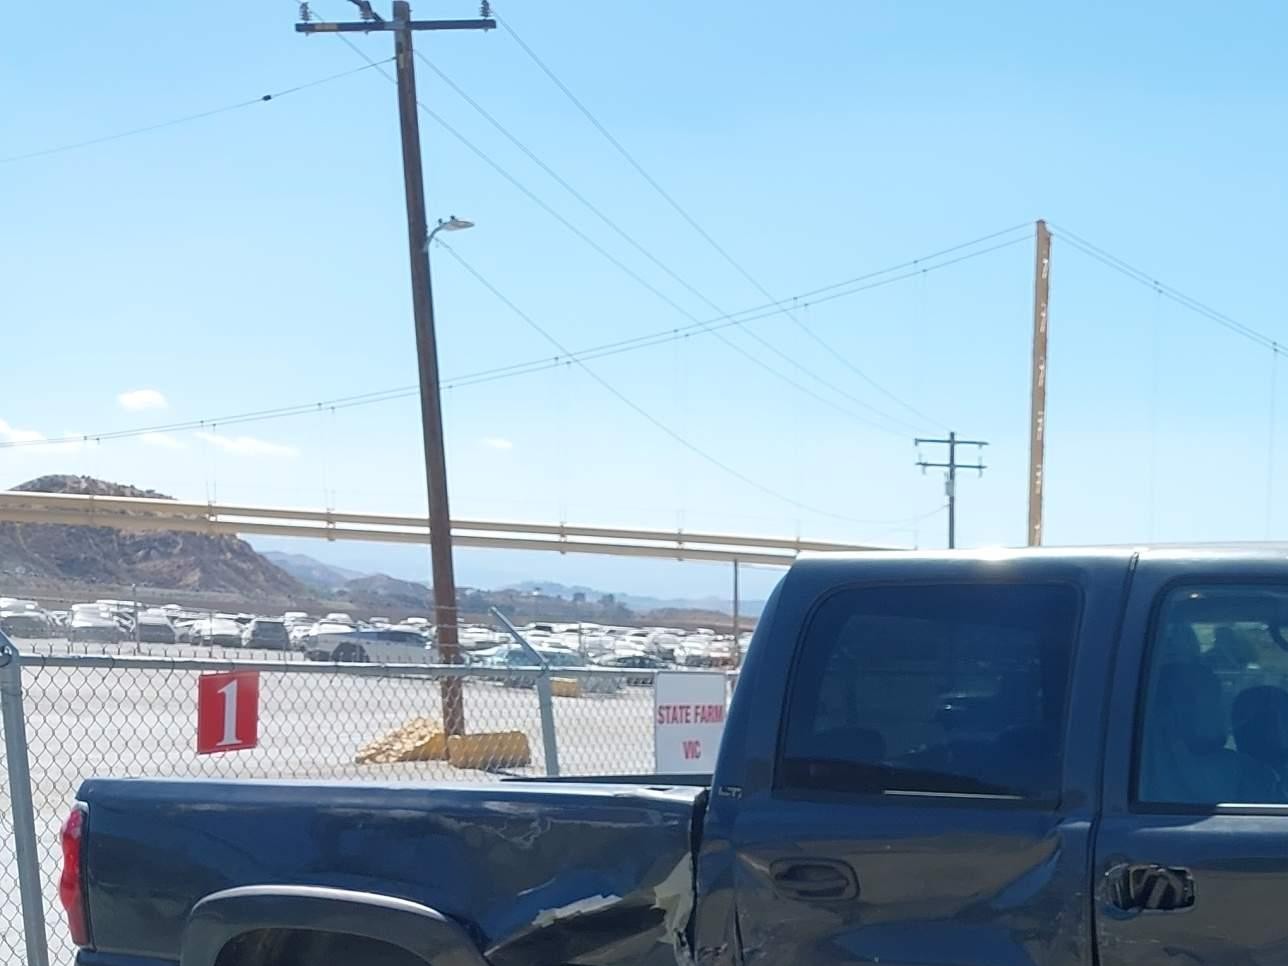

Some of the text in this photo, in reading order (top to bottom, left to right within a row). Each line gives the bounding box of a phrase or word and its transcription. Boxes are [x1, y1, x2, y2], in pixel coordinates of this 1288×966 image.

[216, 679, 243, 746] 1
[658, 703, 724, 725] STATE FARM
[682, 740, 702, 759] VIC
